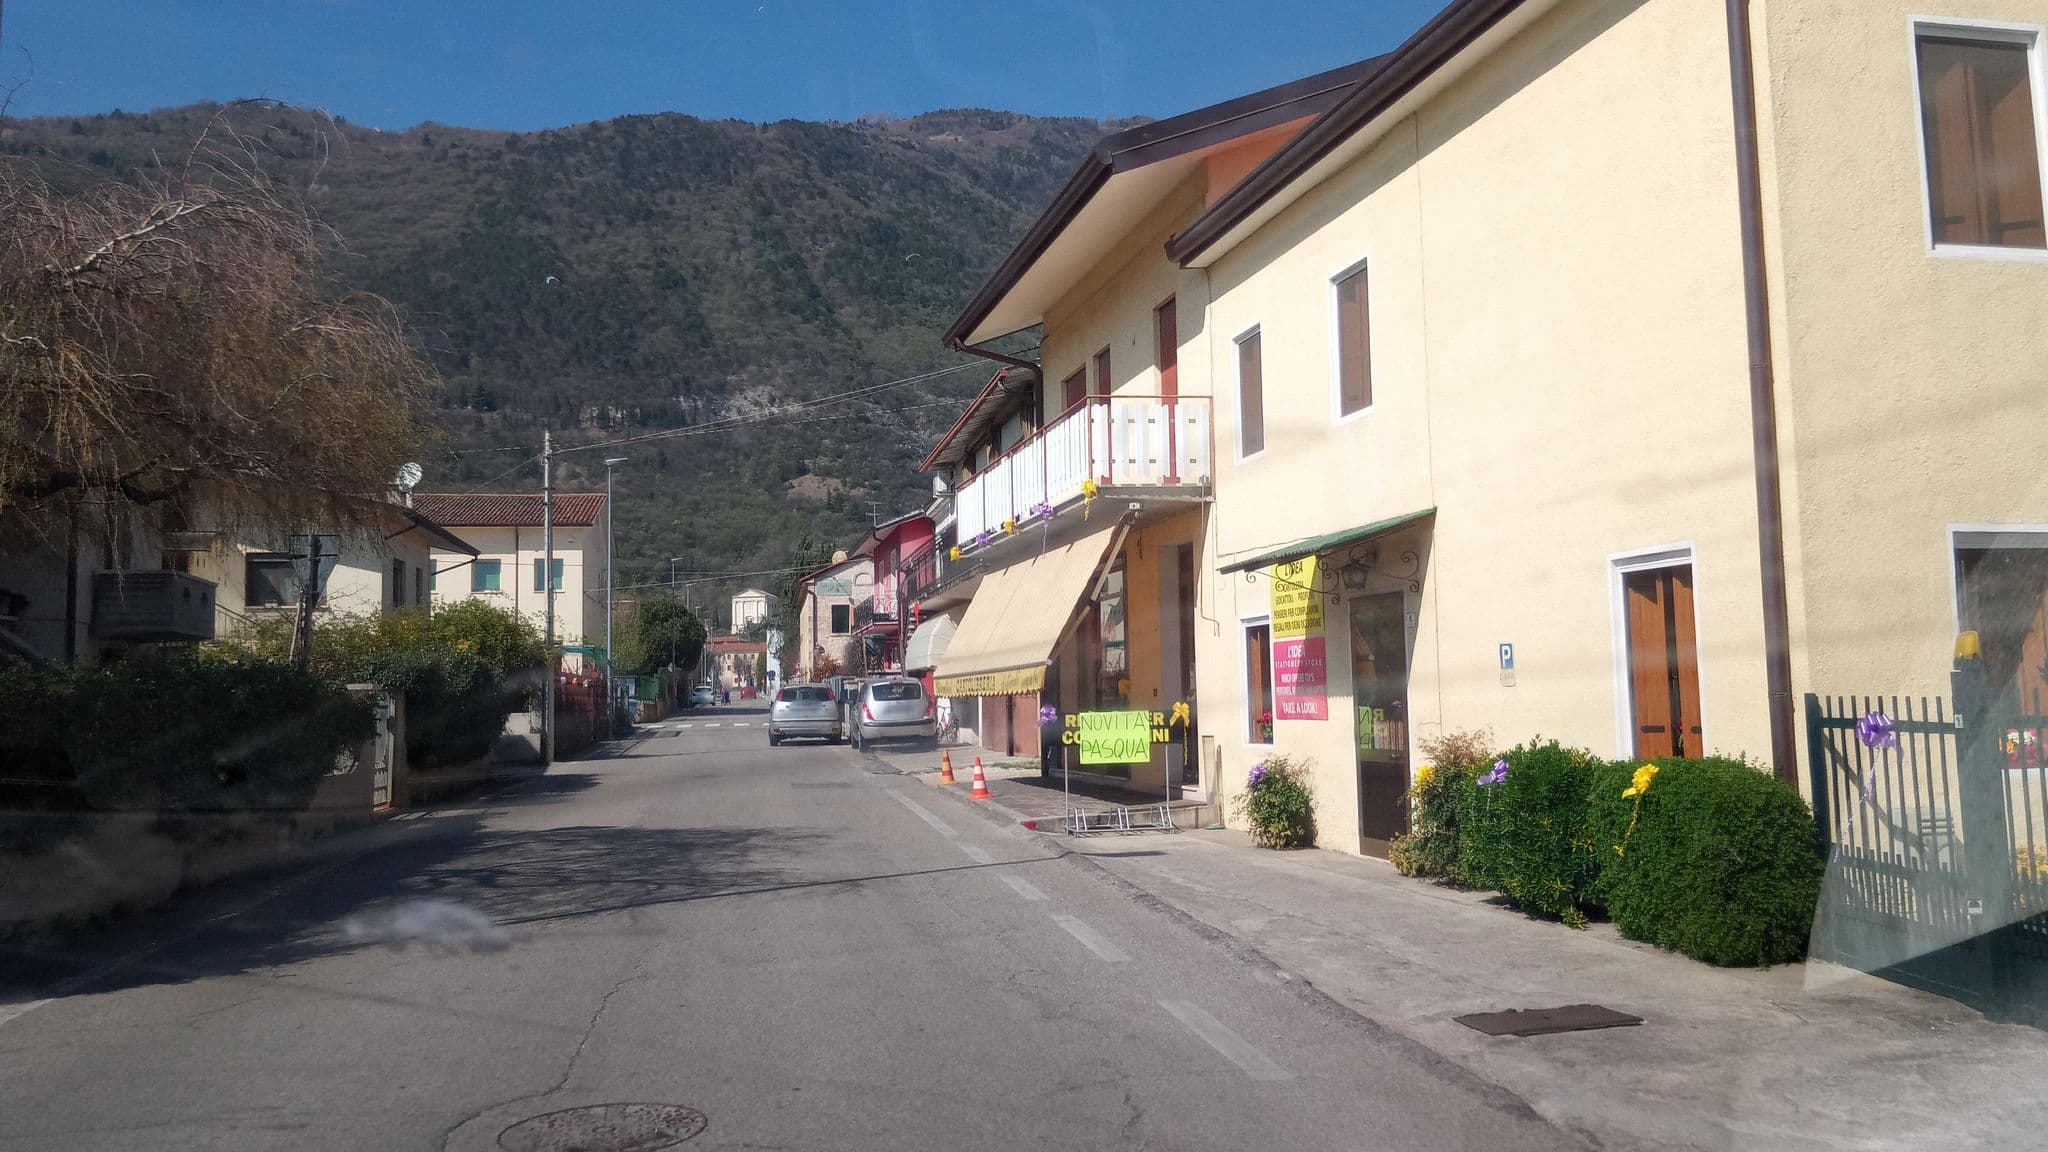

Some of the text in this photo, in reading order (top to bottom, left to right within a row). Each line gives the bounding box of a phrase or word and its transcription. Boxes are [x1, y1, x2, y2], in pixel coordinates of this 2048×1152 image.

[1501, 645, 1511, 668] P
[1282, 702, 1296, 714] TAKE
[1296, 702, 1301, 714] A
[1081, 738, 1149, 760] PASQUA
